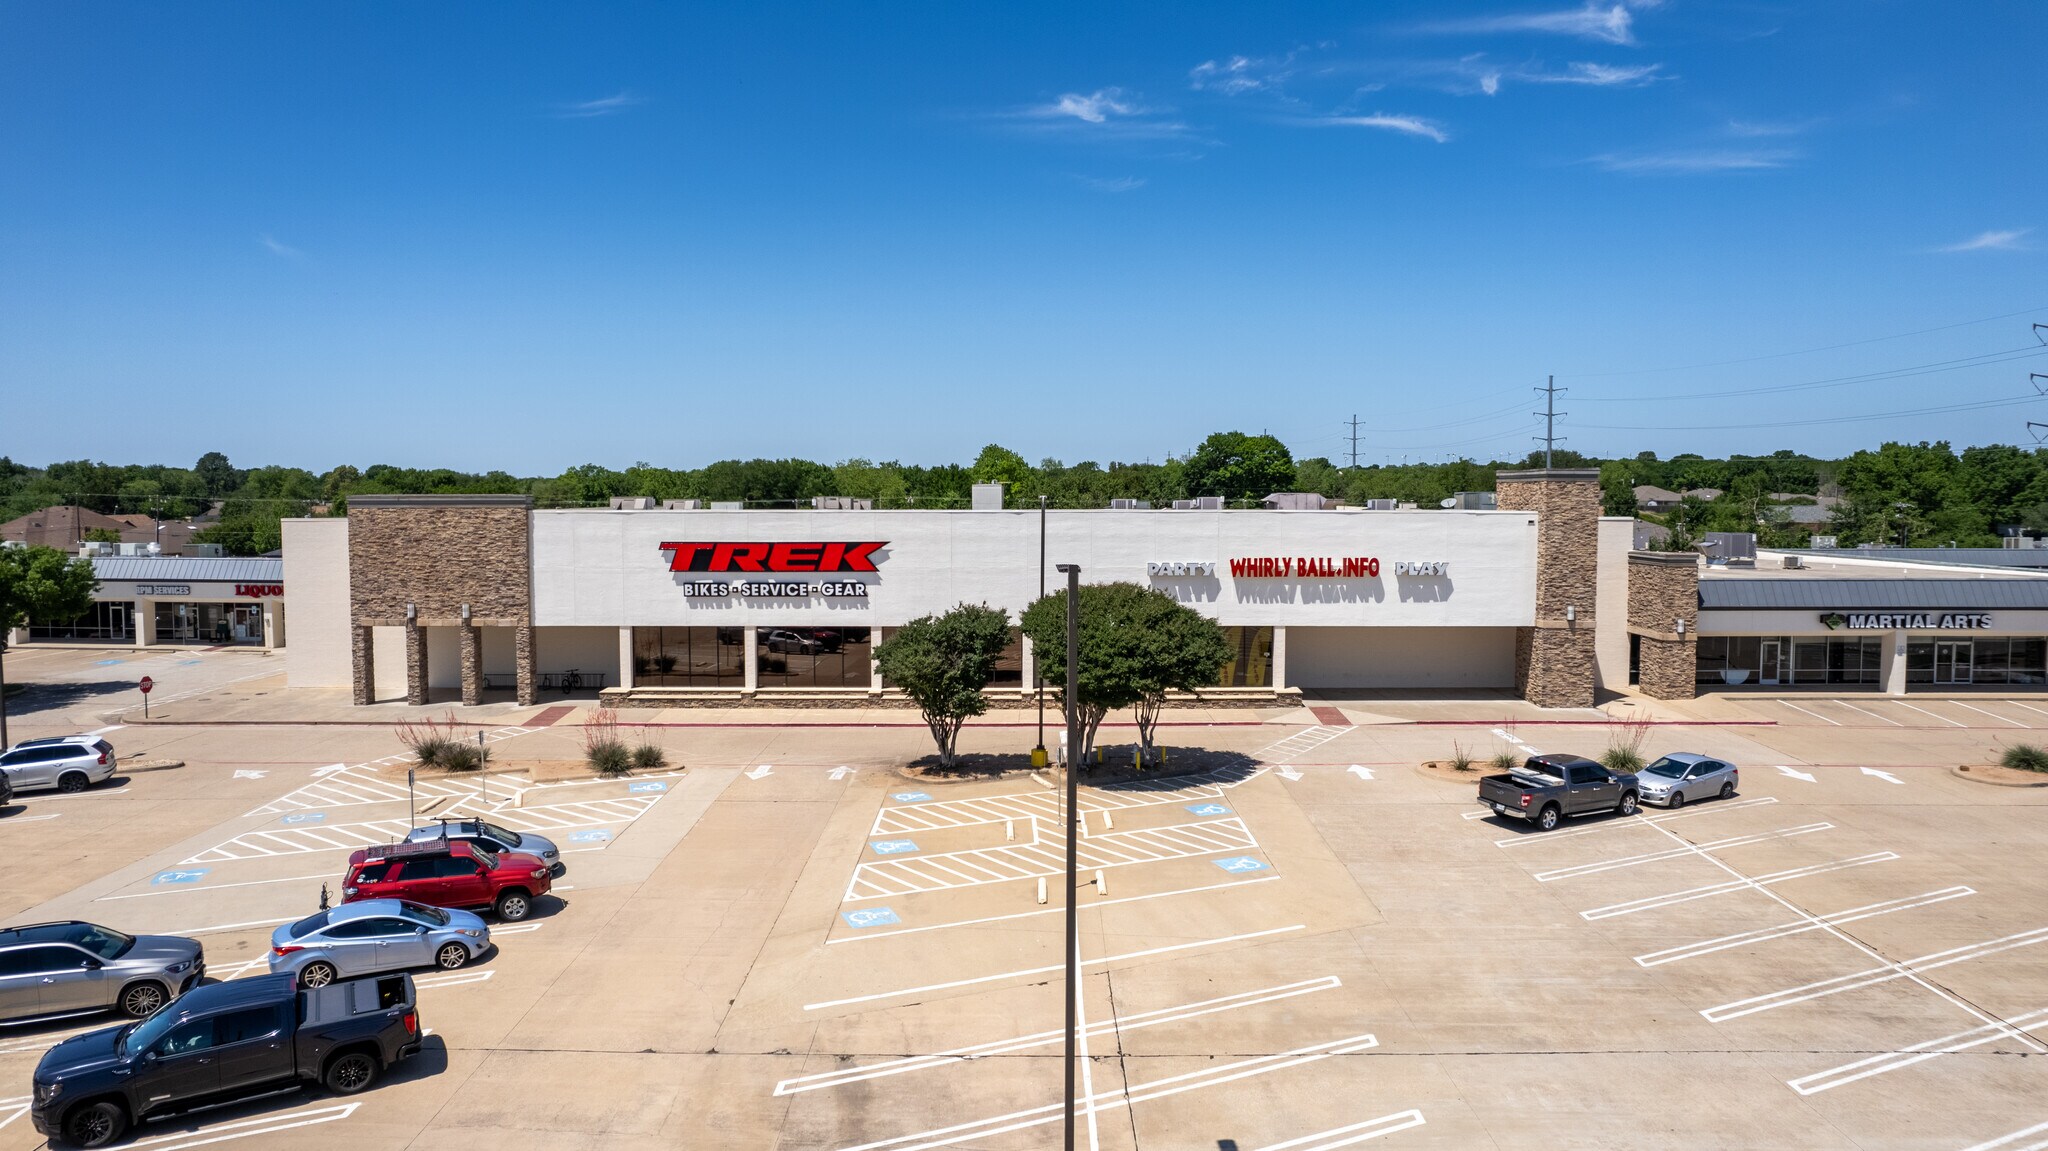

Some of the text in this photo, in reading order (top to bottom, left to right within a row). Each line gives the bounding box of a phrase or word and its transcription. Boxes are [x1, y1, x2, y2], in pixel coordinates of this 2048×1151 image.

[659, 542, 890, 572] TREK
[1147, 562, 1216, 577] PARTY
[1230, 557, 1292, 578] WHIRLY
[1395, 561, 1450, 576] PLAY
[153, 585, 190, 595] SERVICES
[235, 584, 284, 598] LIQUO
[684, 583, 867, 596] BIKES SERVICE GEAR
[1849, 614, 1937, 629] MARTIAL
[1940, 614, 1993, 629] ARTS
[140, 681, 152, 690] STOP
